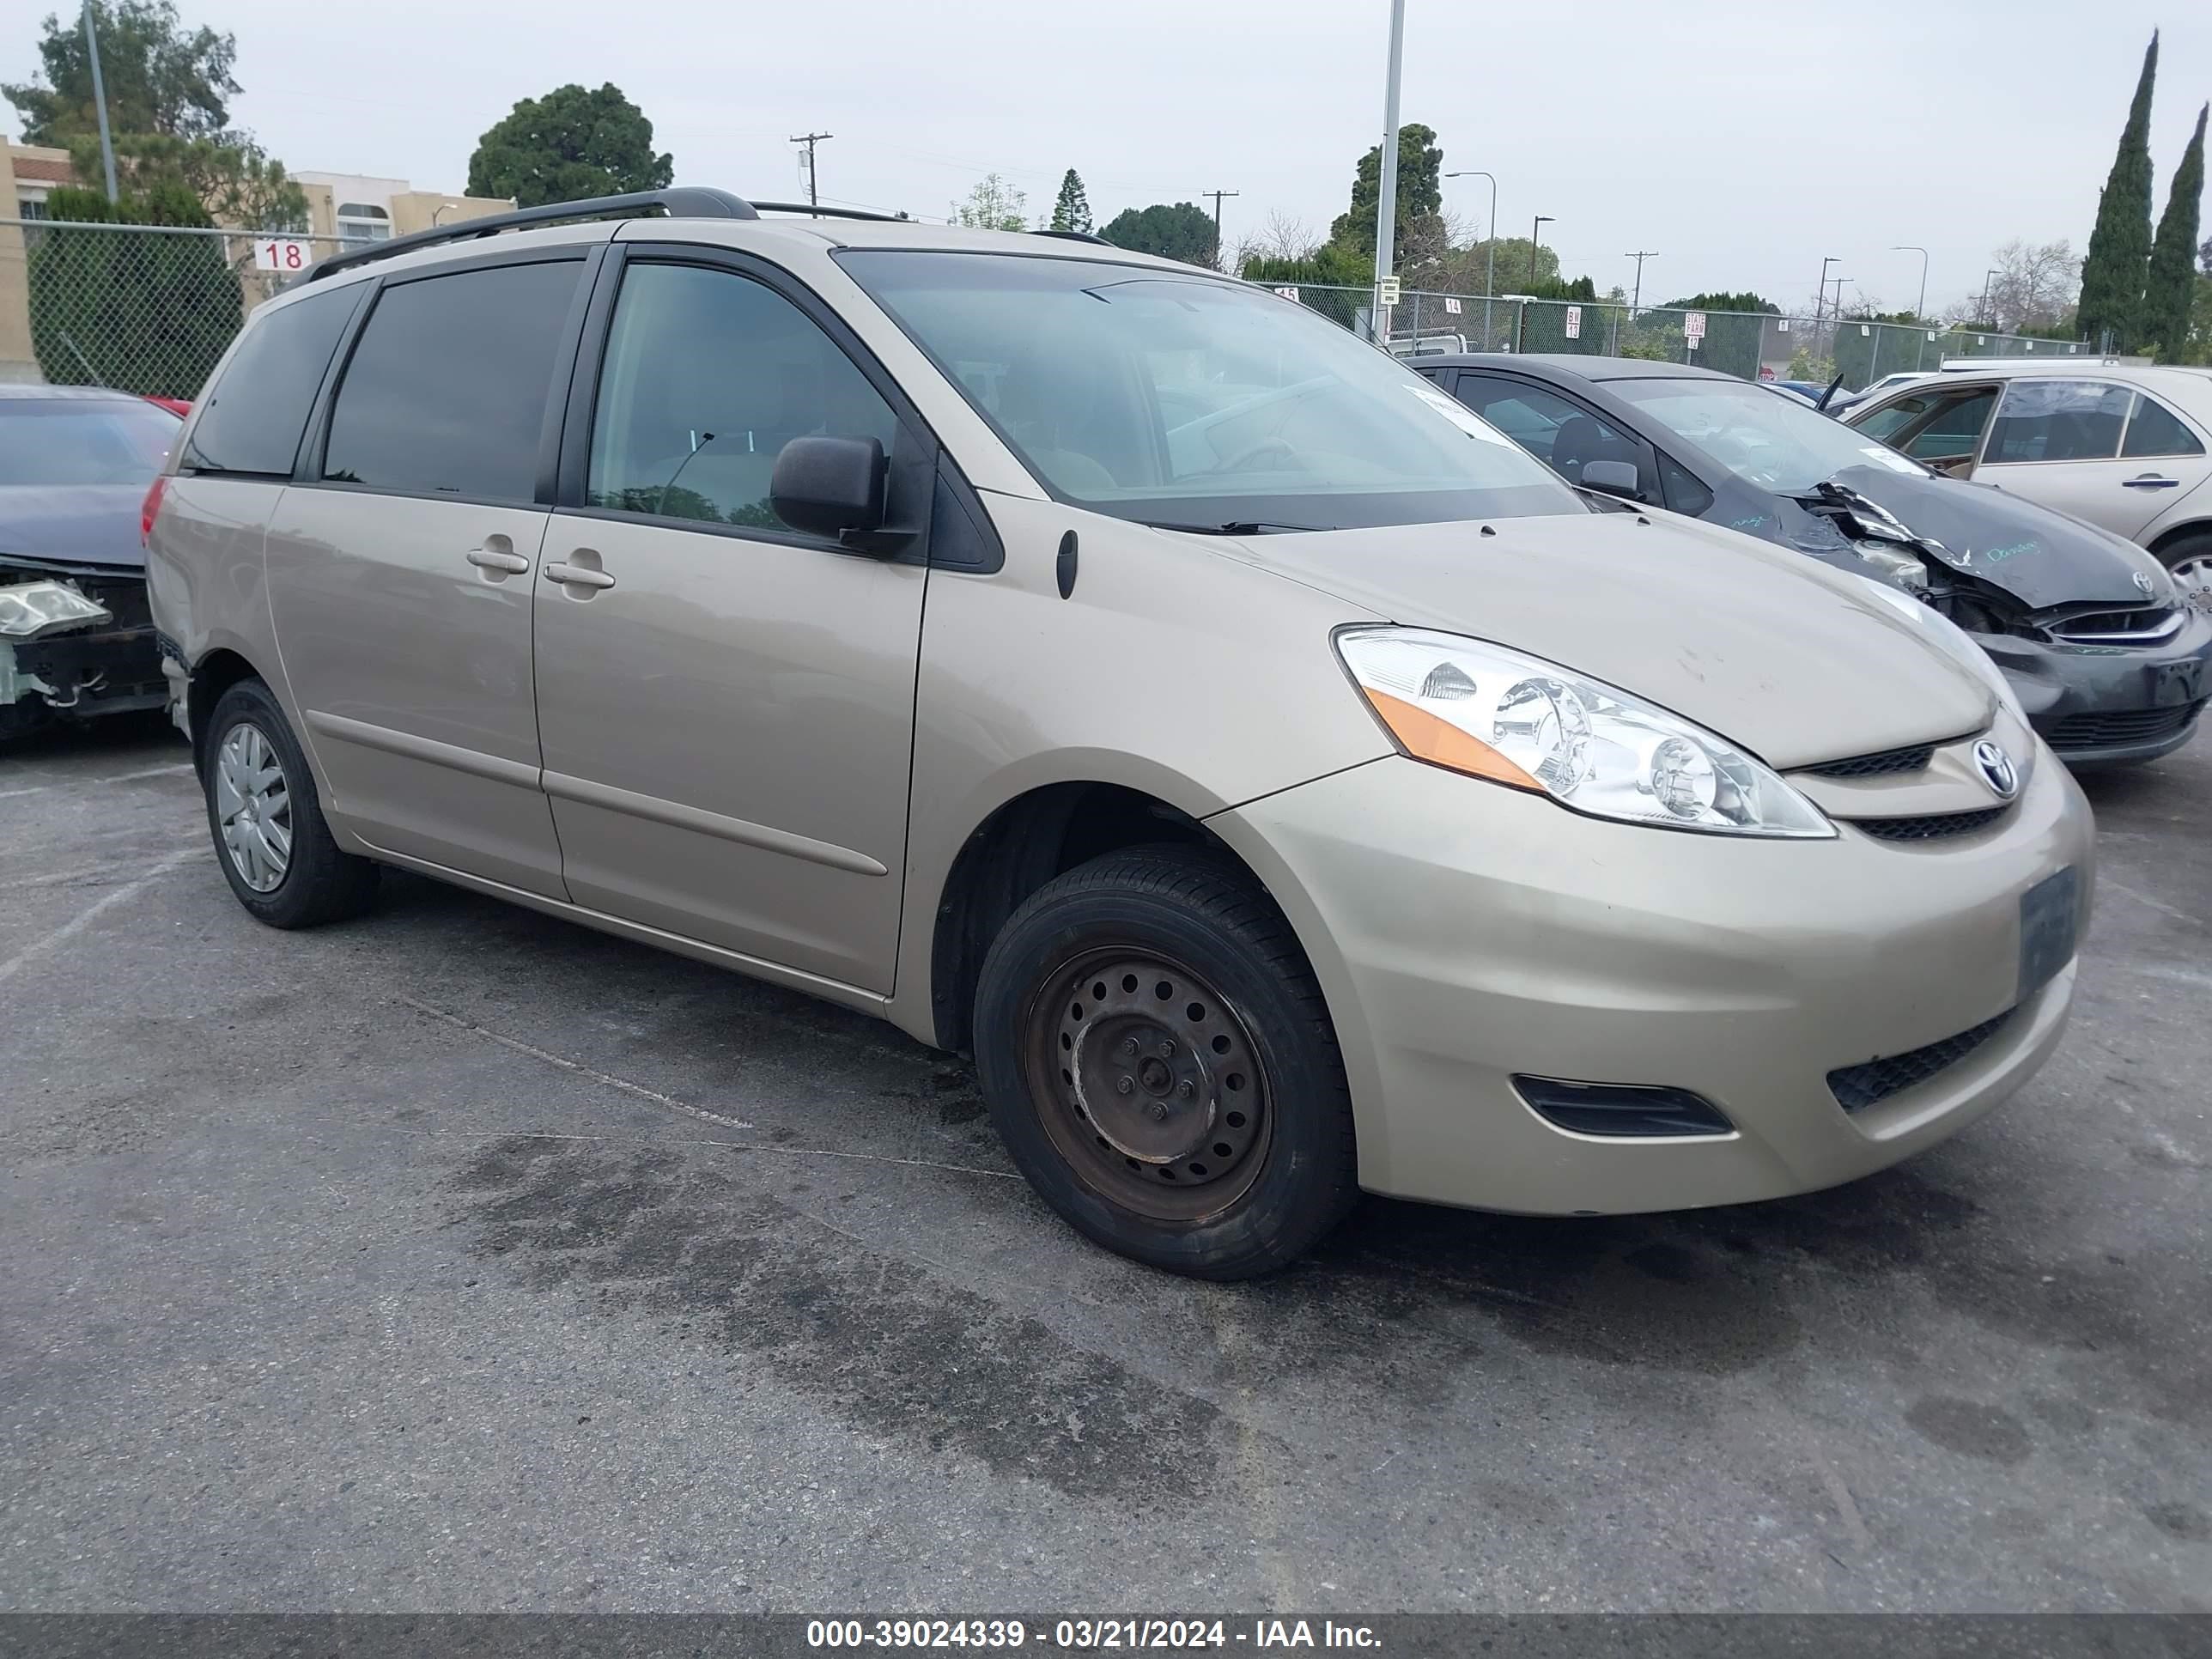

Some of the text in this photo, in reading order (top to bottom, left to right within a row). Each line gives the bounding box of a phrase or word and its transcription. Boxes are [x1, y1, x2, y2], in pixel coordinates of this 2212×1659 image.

[266, 244, 301, 268] 18
[1448, 300, 1459, 313] 14
[1569, 311, 1580, 322] BW
[1686, 313, 1705, 324] STATE
[1569, 325, 1578, 337] 13
[1686, 324, 1704, 333] FARM
[1690, 337, 1698, 348] 12
